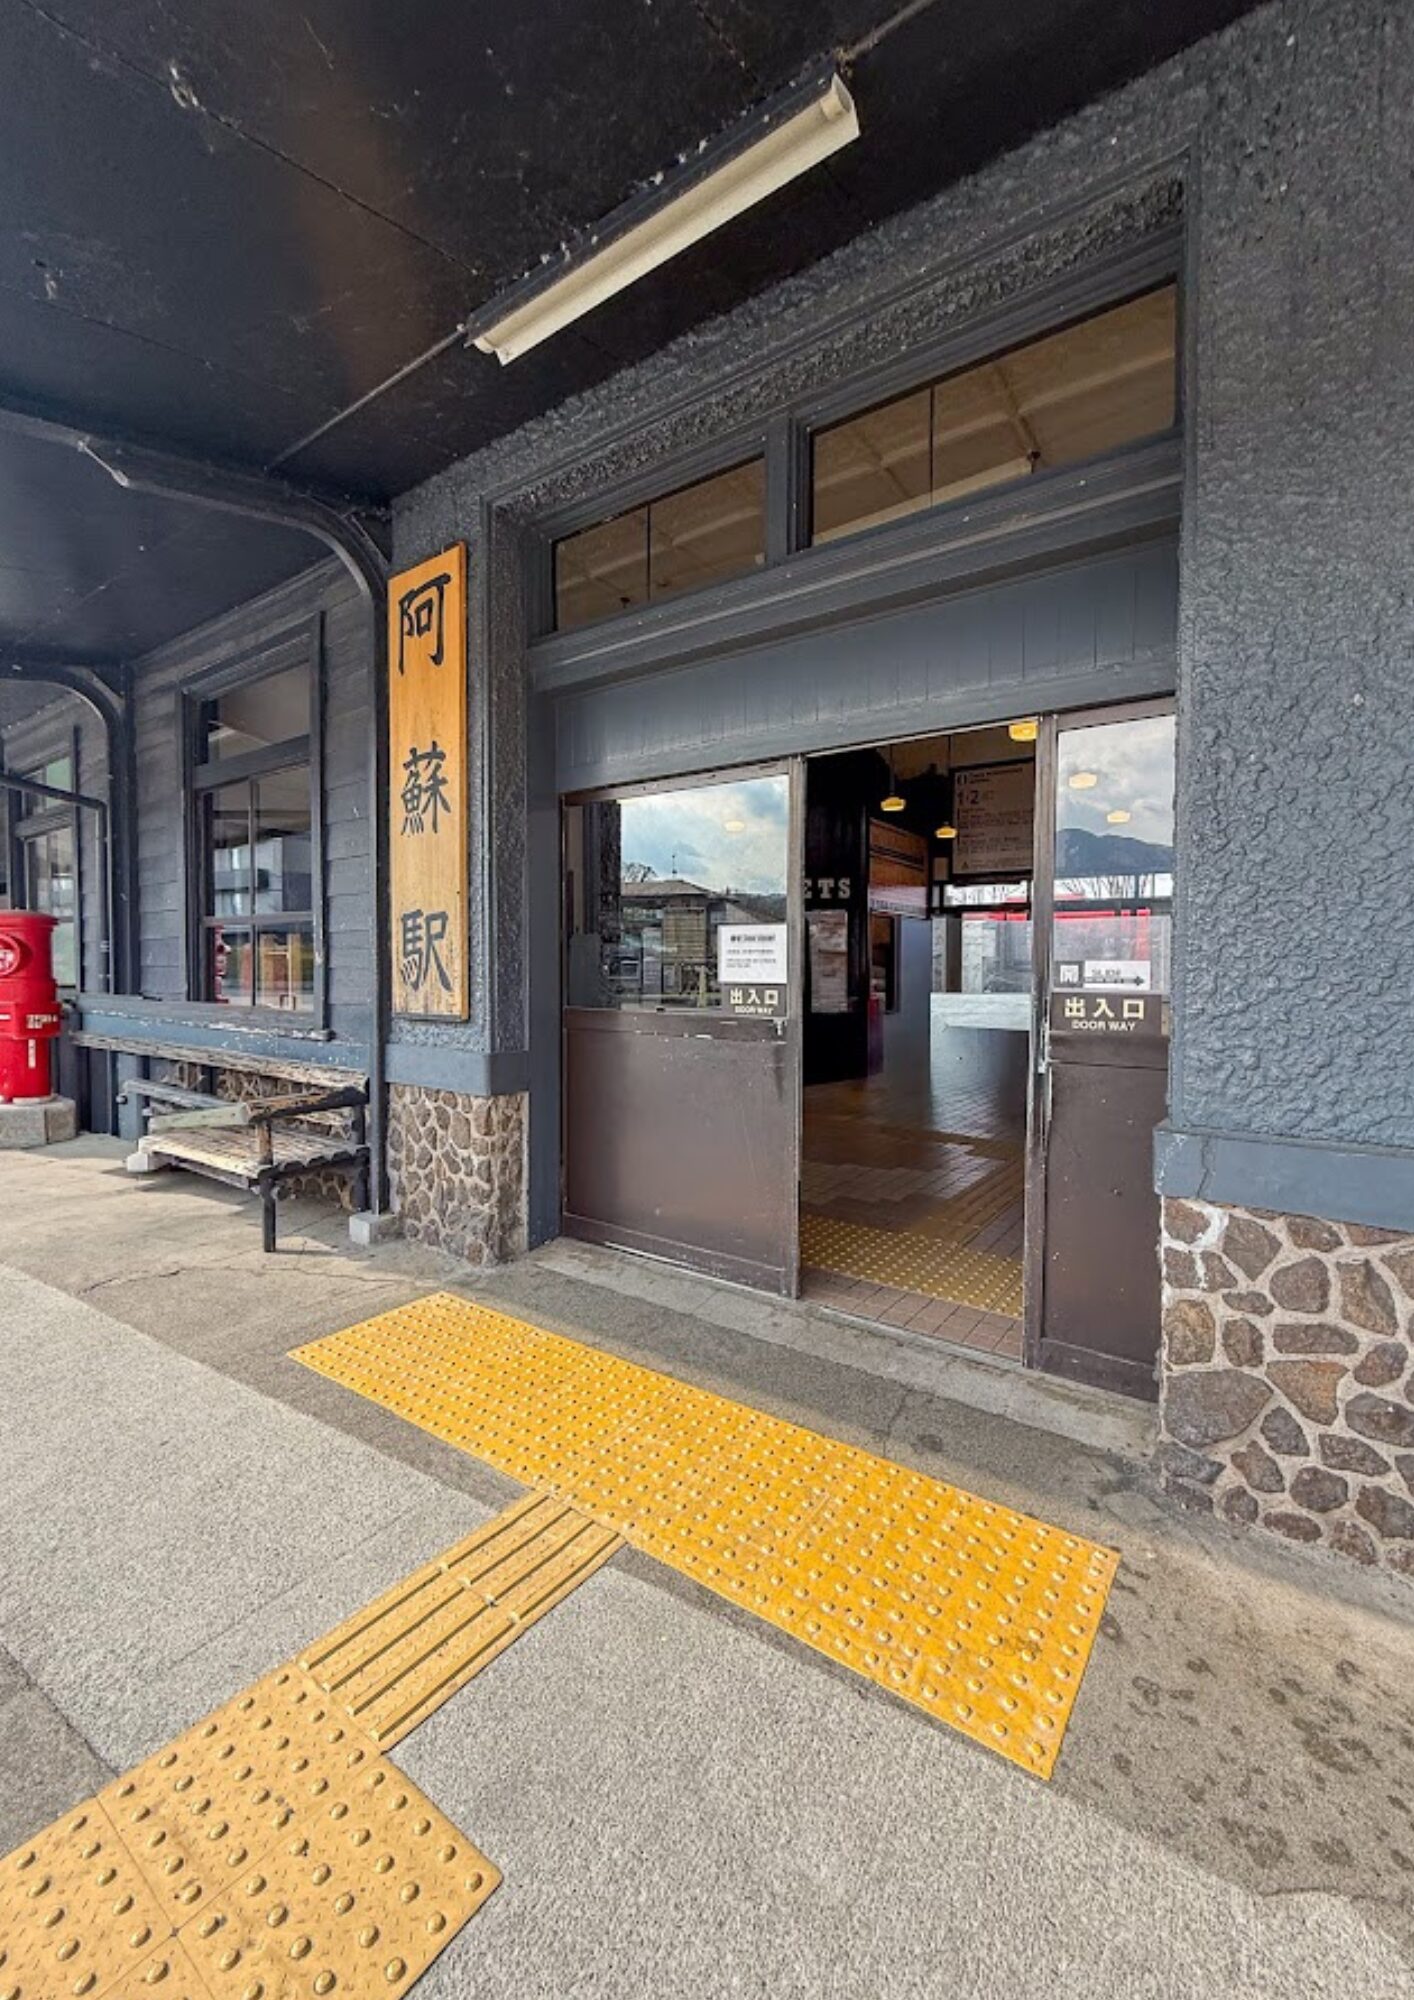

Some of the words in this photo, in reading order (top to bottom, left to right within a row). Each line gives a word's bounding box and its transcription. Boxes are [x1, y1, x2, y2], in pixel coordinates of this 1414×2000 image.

[398, 572, 453, 995] 阿蘇駅
[730, 987, 779, 1004] 出入口
[1064, 997, 1145, 1020] 出入口
[1071, 1020, 1106, 1031] DOOR
[1107, 1020, 1136, 1032] WAY
